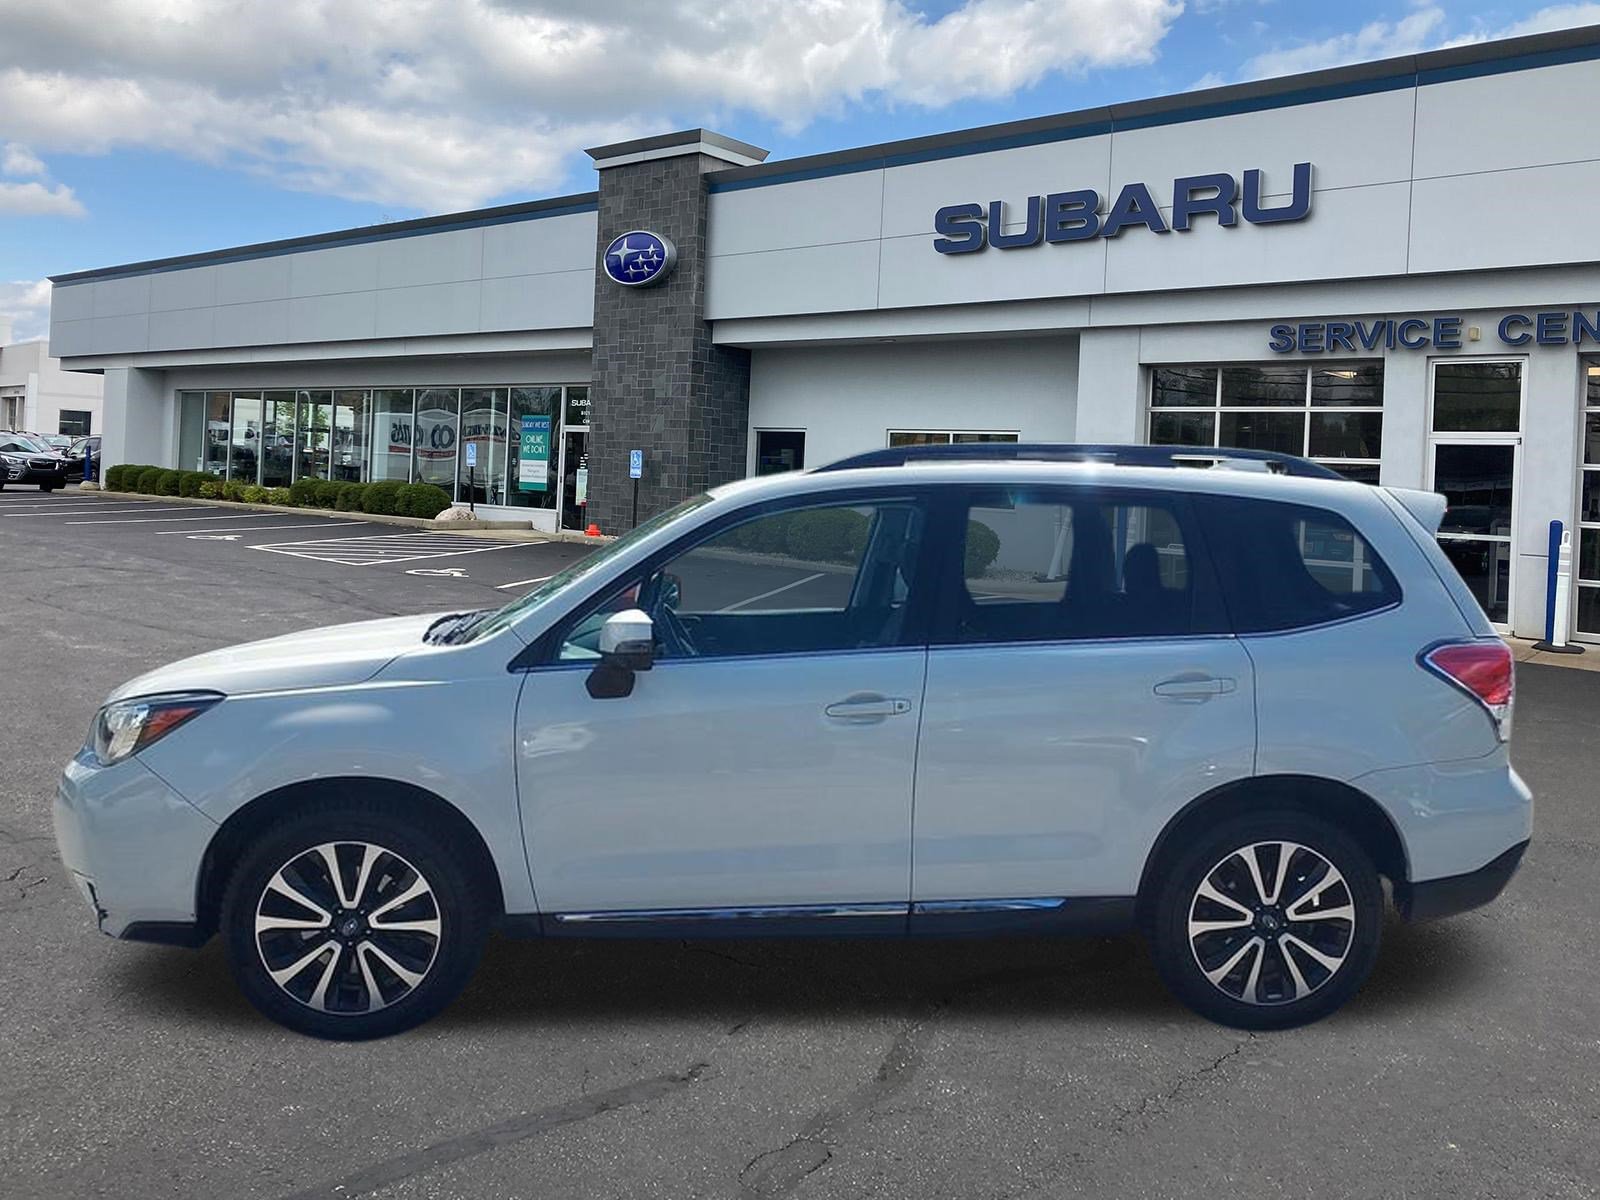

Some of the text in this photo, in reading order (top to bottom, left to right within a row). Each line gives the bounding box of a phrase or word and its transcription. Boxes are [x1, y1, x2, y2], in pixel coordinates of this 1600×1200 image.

[933, 161, 1314, 255] SUBARU
[1268, 311, 1600, 353] SERVICE CEN
